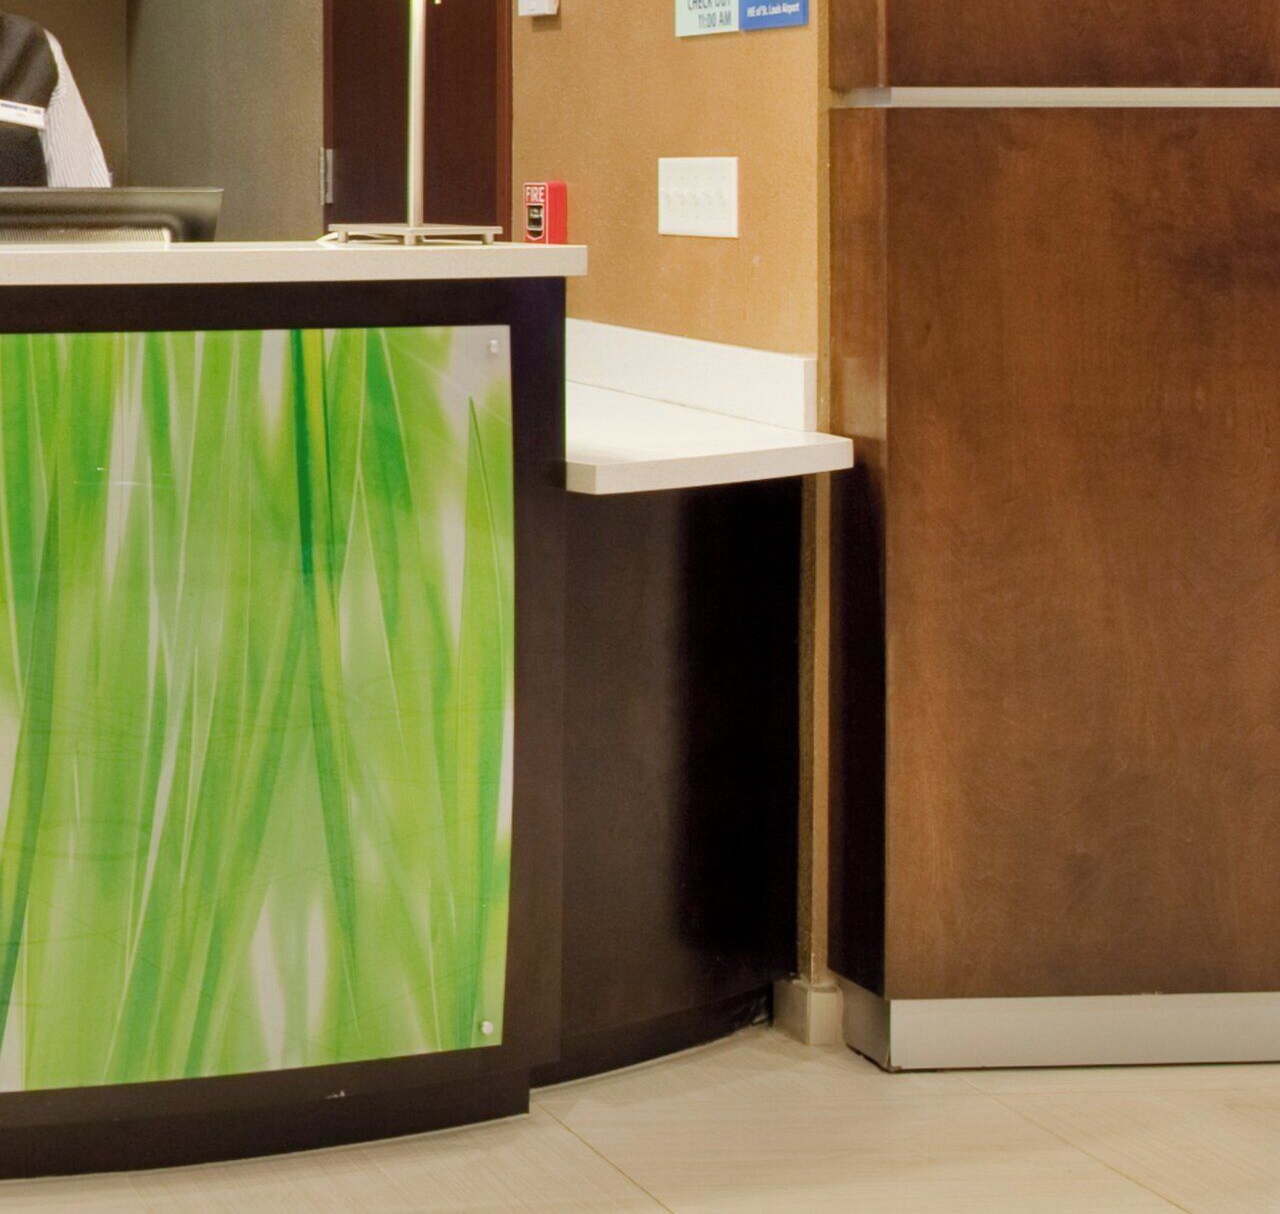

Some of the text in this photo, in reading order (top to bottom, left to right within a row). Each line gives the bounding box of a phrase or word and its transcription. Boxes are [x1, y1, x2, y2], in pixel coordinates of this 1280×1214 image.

[782, 2, 800, 15] Airport
[698, 10, 731, 29] 11:00 AM
[525, 186, 545, 202] FIRE
